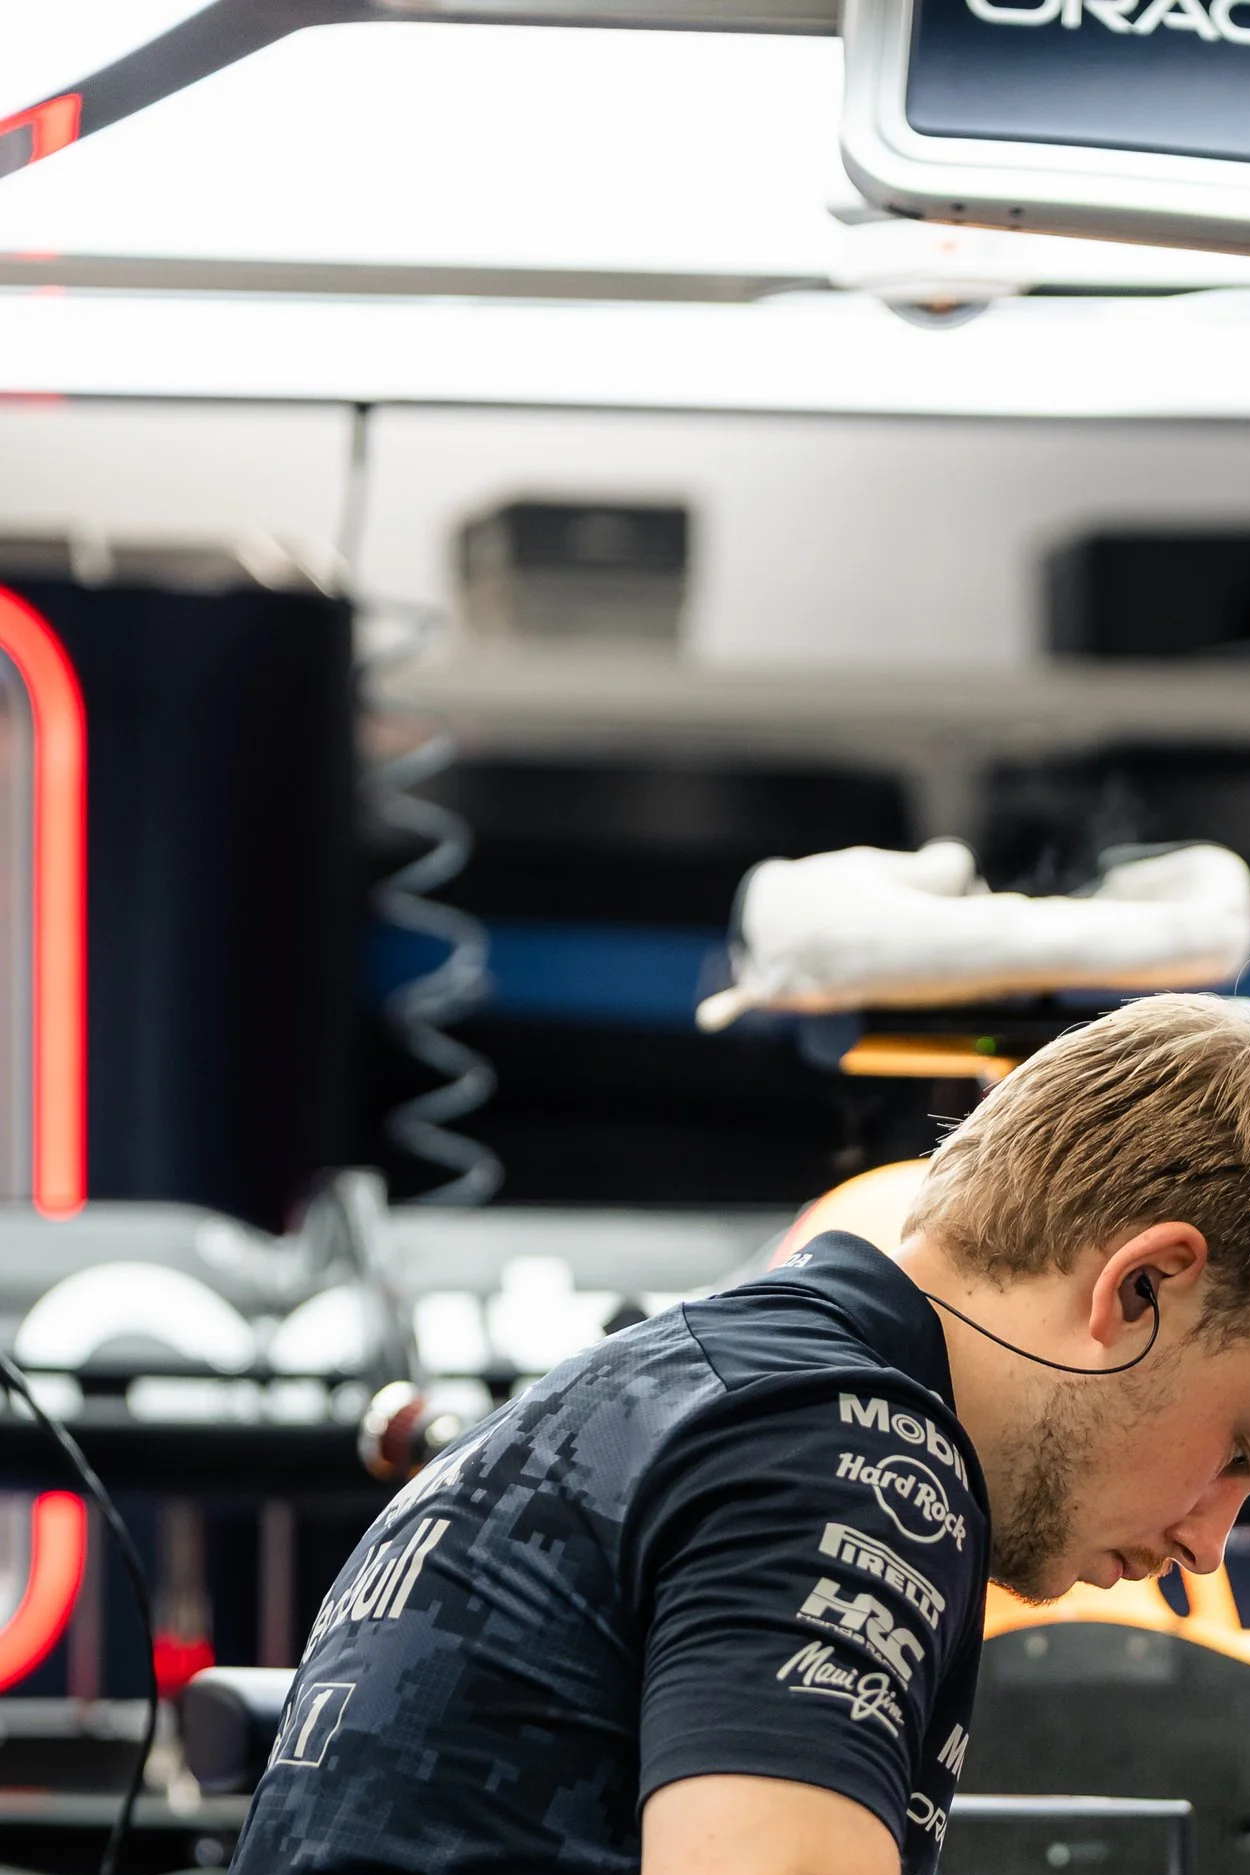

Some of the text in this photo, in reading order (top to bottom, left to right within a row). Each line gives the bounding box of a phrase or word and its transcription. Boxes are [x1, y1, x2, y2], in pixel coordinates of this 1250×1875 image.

[835, 1452, 967, 1552] Hard Rock
[818, 1522, 946, 1630] PIRELLI
[800, 1577, 926, 1682] HRC
[777, 1640, 905, 1726] Maui Jim
